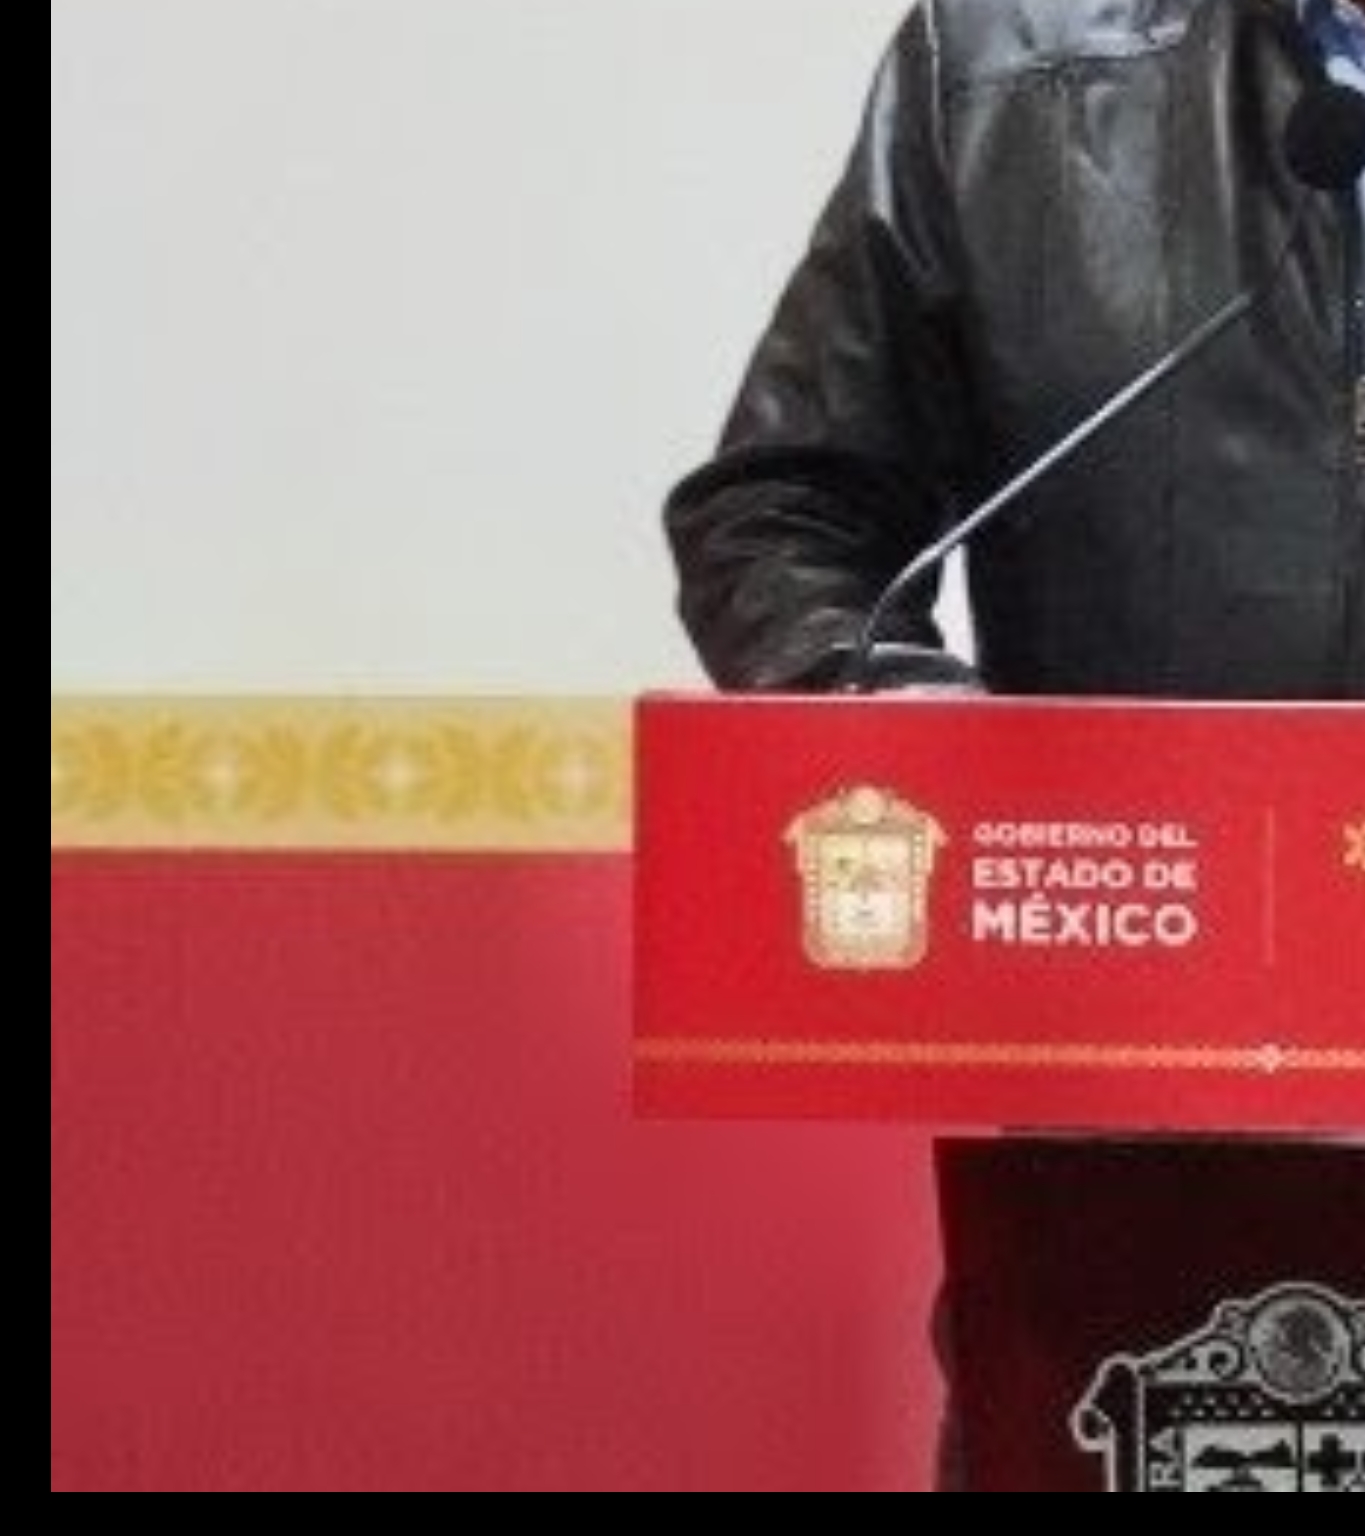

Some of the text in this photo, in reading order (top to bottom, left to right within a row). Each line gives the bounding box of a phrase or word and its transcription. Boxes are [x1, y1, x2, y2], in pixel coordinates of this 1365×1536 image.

[973, 822, 1198, 849] GOBIERNO DEL
[972, 857, 1198, 890] ESTADO DE
[972, 891, 1198, 947] MÉXICO
